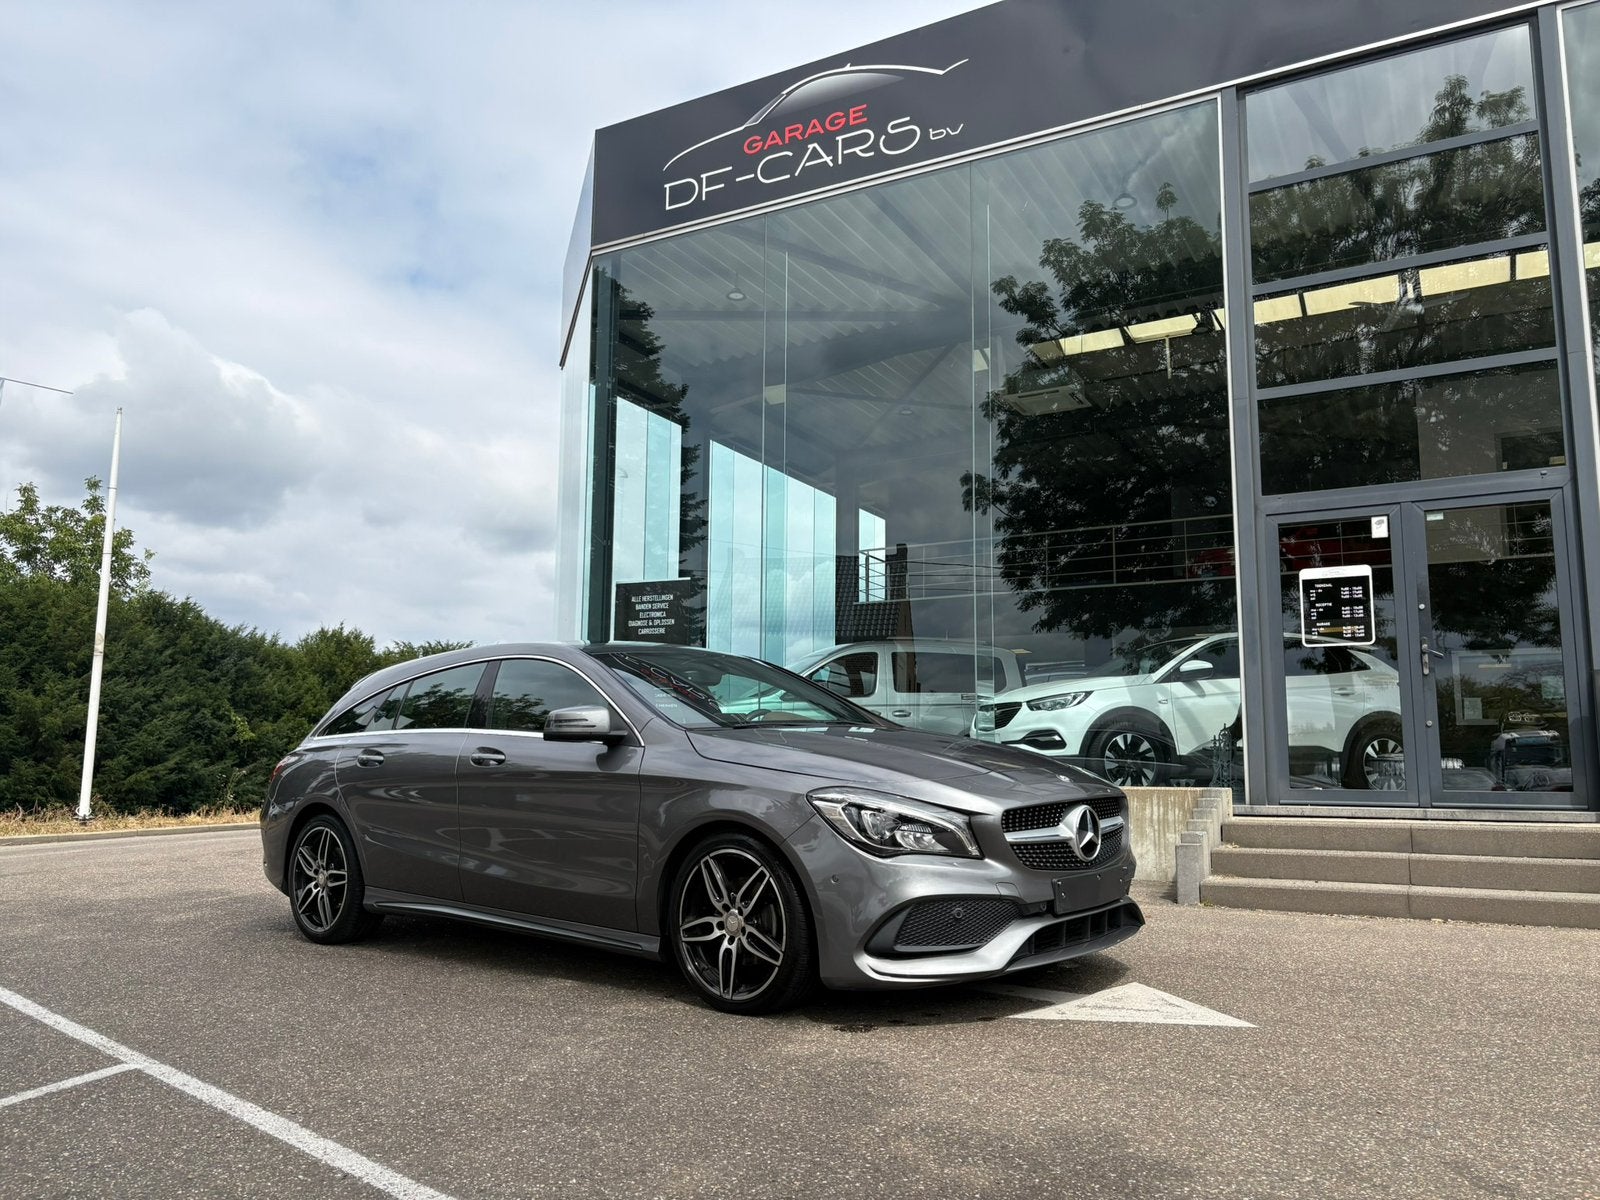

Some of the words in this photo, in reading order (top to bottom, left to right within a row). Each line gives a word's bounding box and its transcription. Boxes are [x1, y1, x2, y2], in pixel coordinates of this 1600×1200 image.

[743, 104, 868, 156] GARAGE
[663, 116, 921, 211] DF-CARS
[929, 123, 964, 141] bv
[642, 594, 673, 602] HERSTELLINGEN
[652, 602, 669, 610] SERVICE
[639, 611, 666, 619] ELECTRONICA
[638, 627, 666, 635] CARROSSERIE
